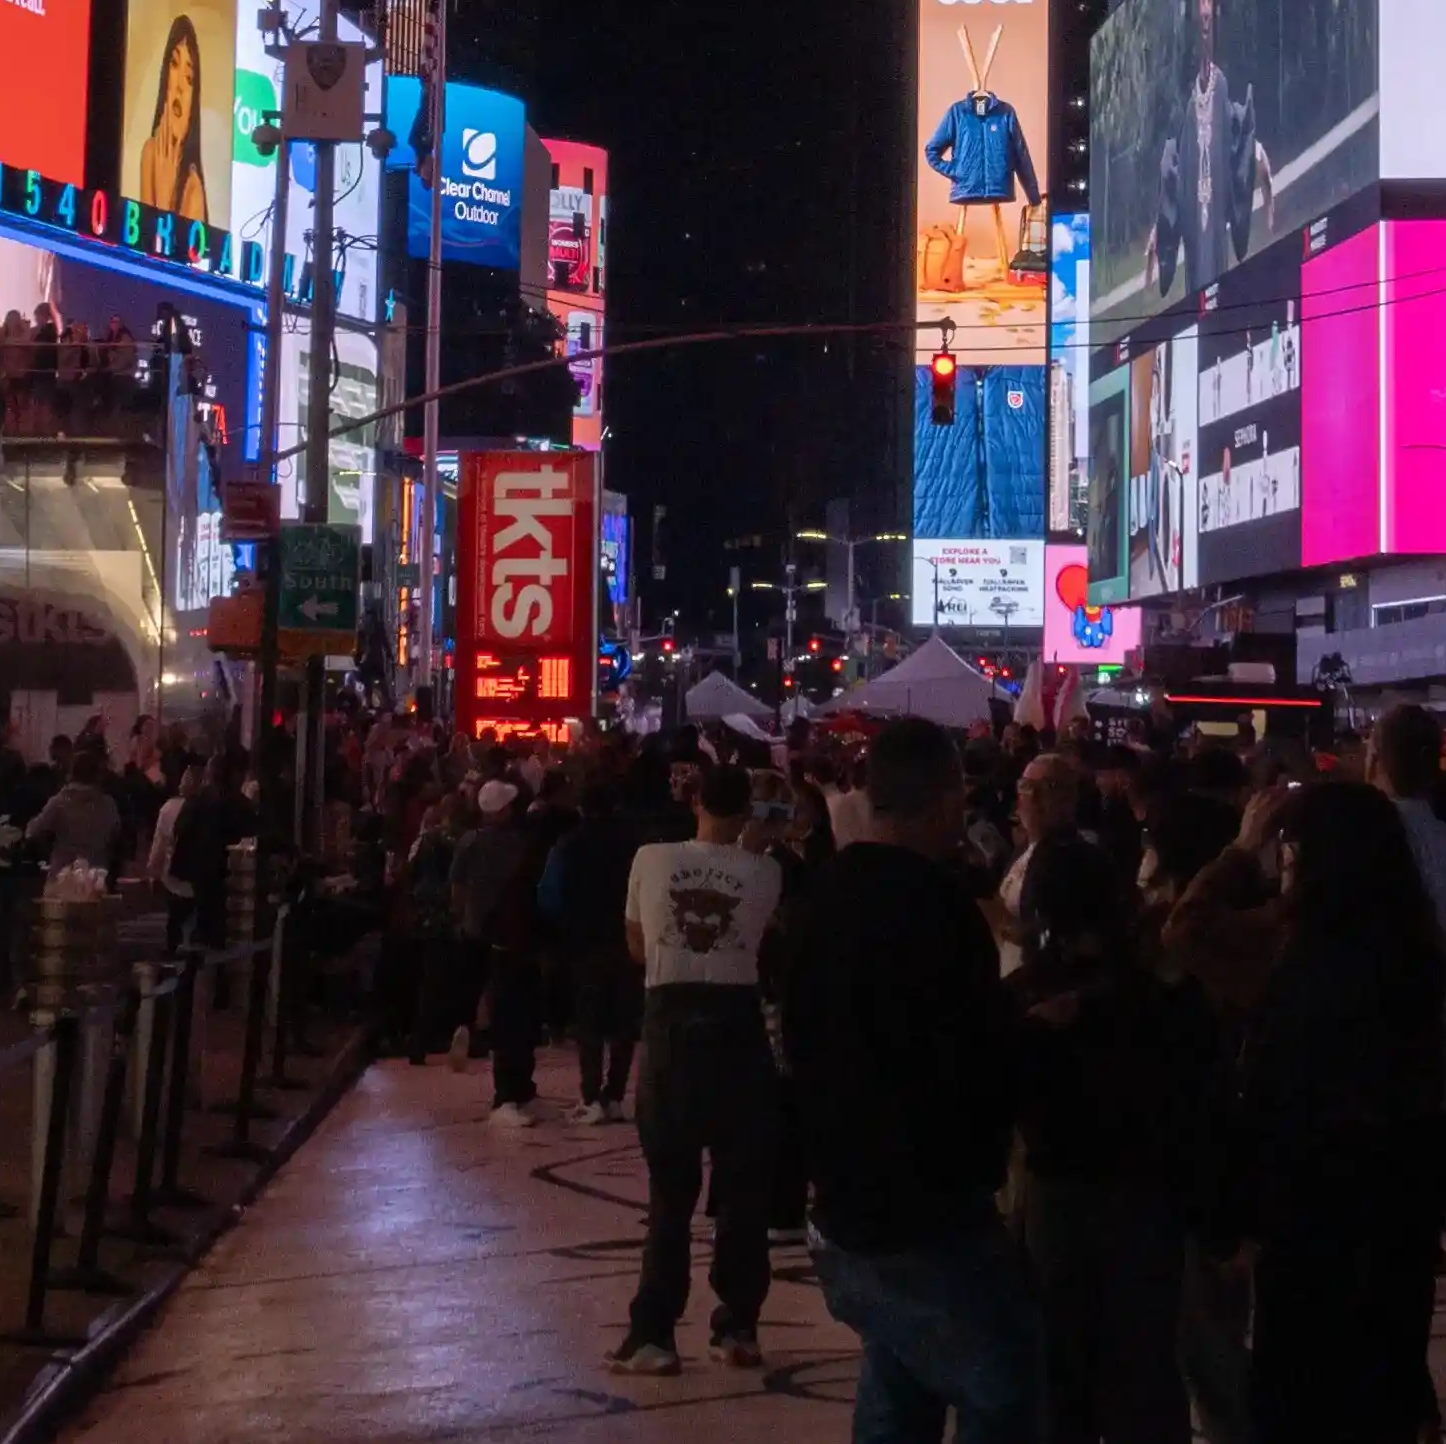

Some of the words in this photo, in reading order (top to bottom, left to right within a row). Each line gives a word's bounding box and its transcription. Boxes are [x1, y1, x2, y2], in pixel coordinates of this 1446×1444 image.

[472, 181, 510, 207] Channel
[454, 201, 500, 226] Outdoor
[491, 464, 574, 639] tkts
[941, 547, 980, 556] EXPLORE
[958, 556, 981, 566] NEAR
[283, 570, 353, 590] South
